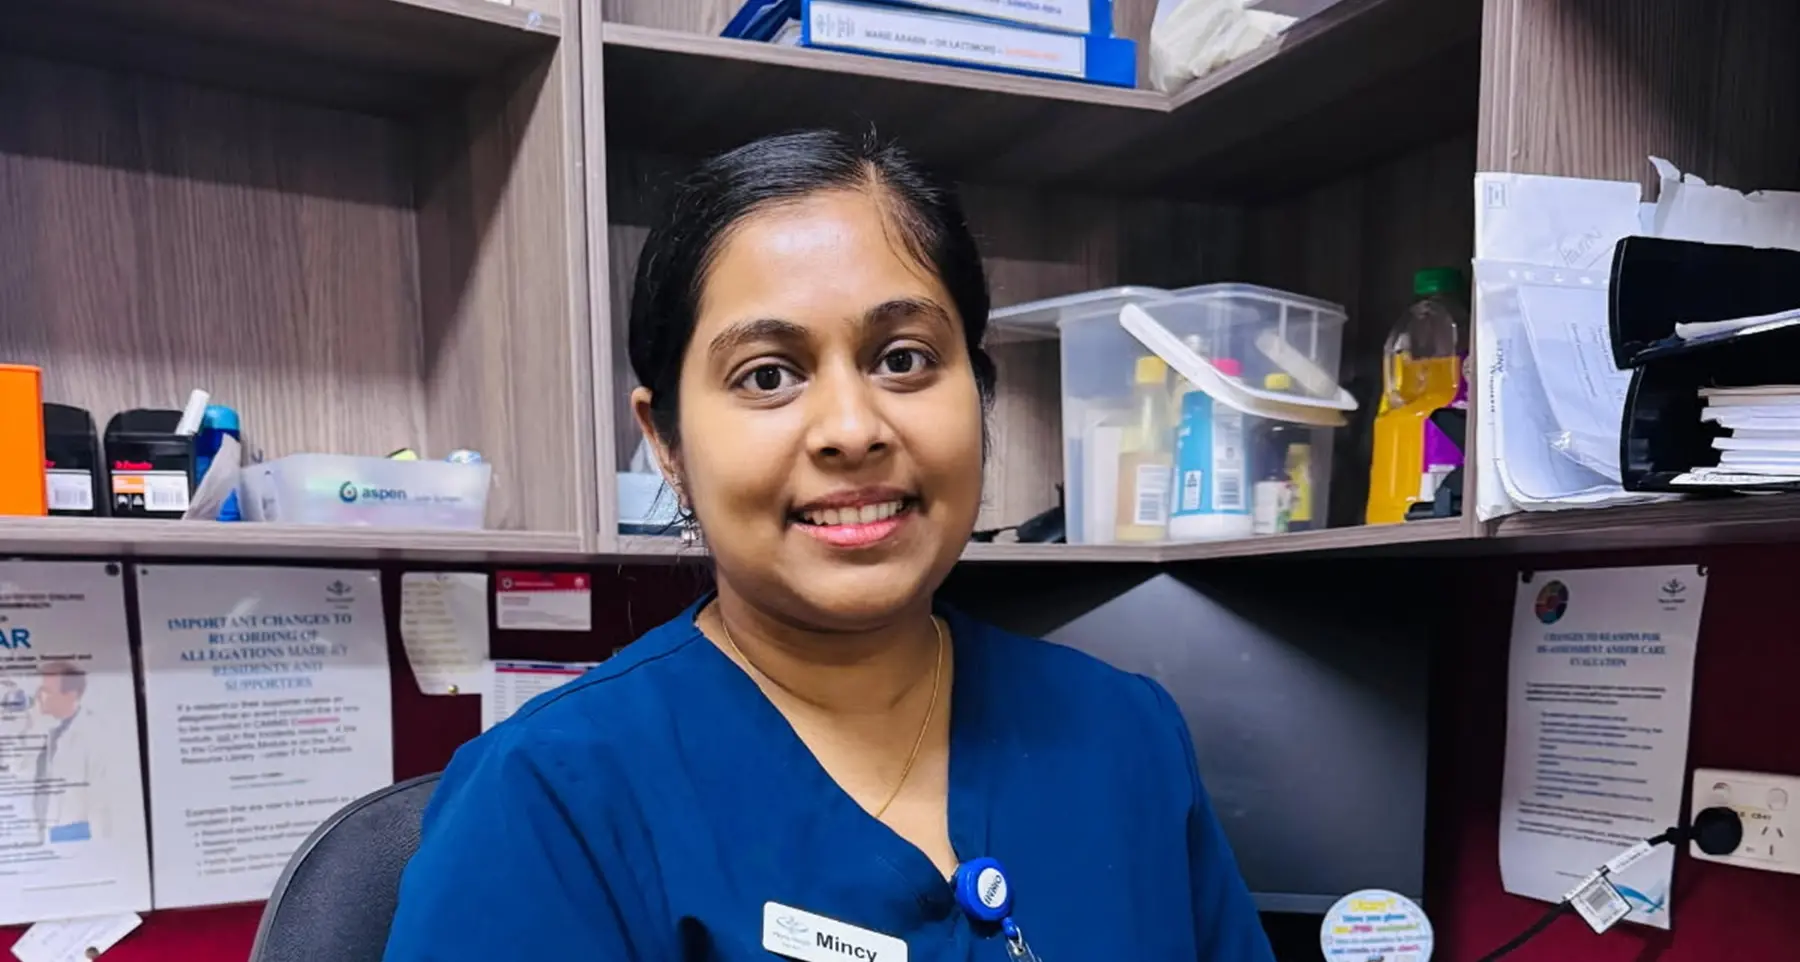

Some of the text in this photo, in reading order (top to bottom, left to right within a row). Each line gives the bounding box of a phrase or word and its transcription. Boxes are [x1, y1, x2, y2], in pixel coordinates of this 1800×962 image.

[362, 487, 407, 501] aspen
[168, 612, 352, 631] IMPORTANT CHANGES TO
[208, 629, 318, 645] RECORDING OF
[179, 647, 286, 662] ALLEGATIONS
[287, 645, 328, 658] MADE
[225, 676, 313, 692] SUPPORTERS
[816, 931, 877, 962] Mincy
